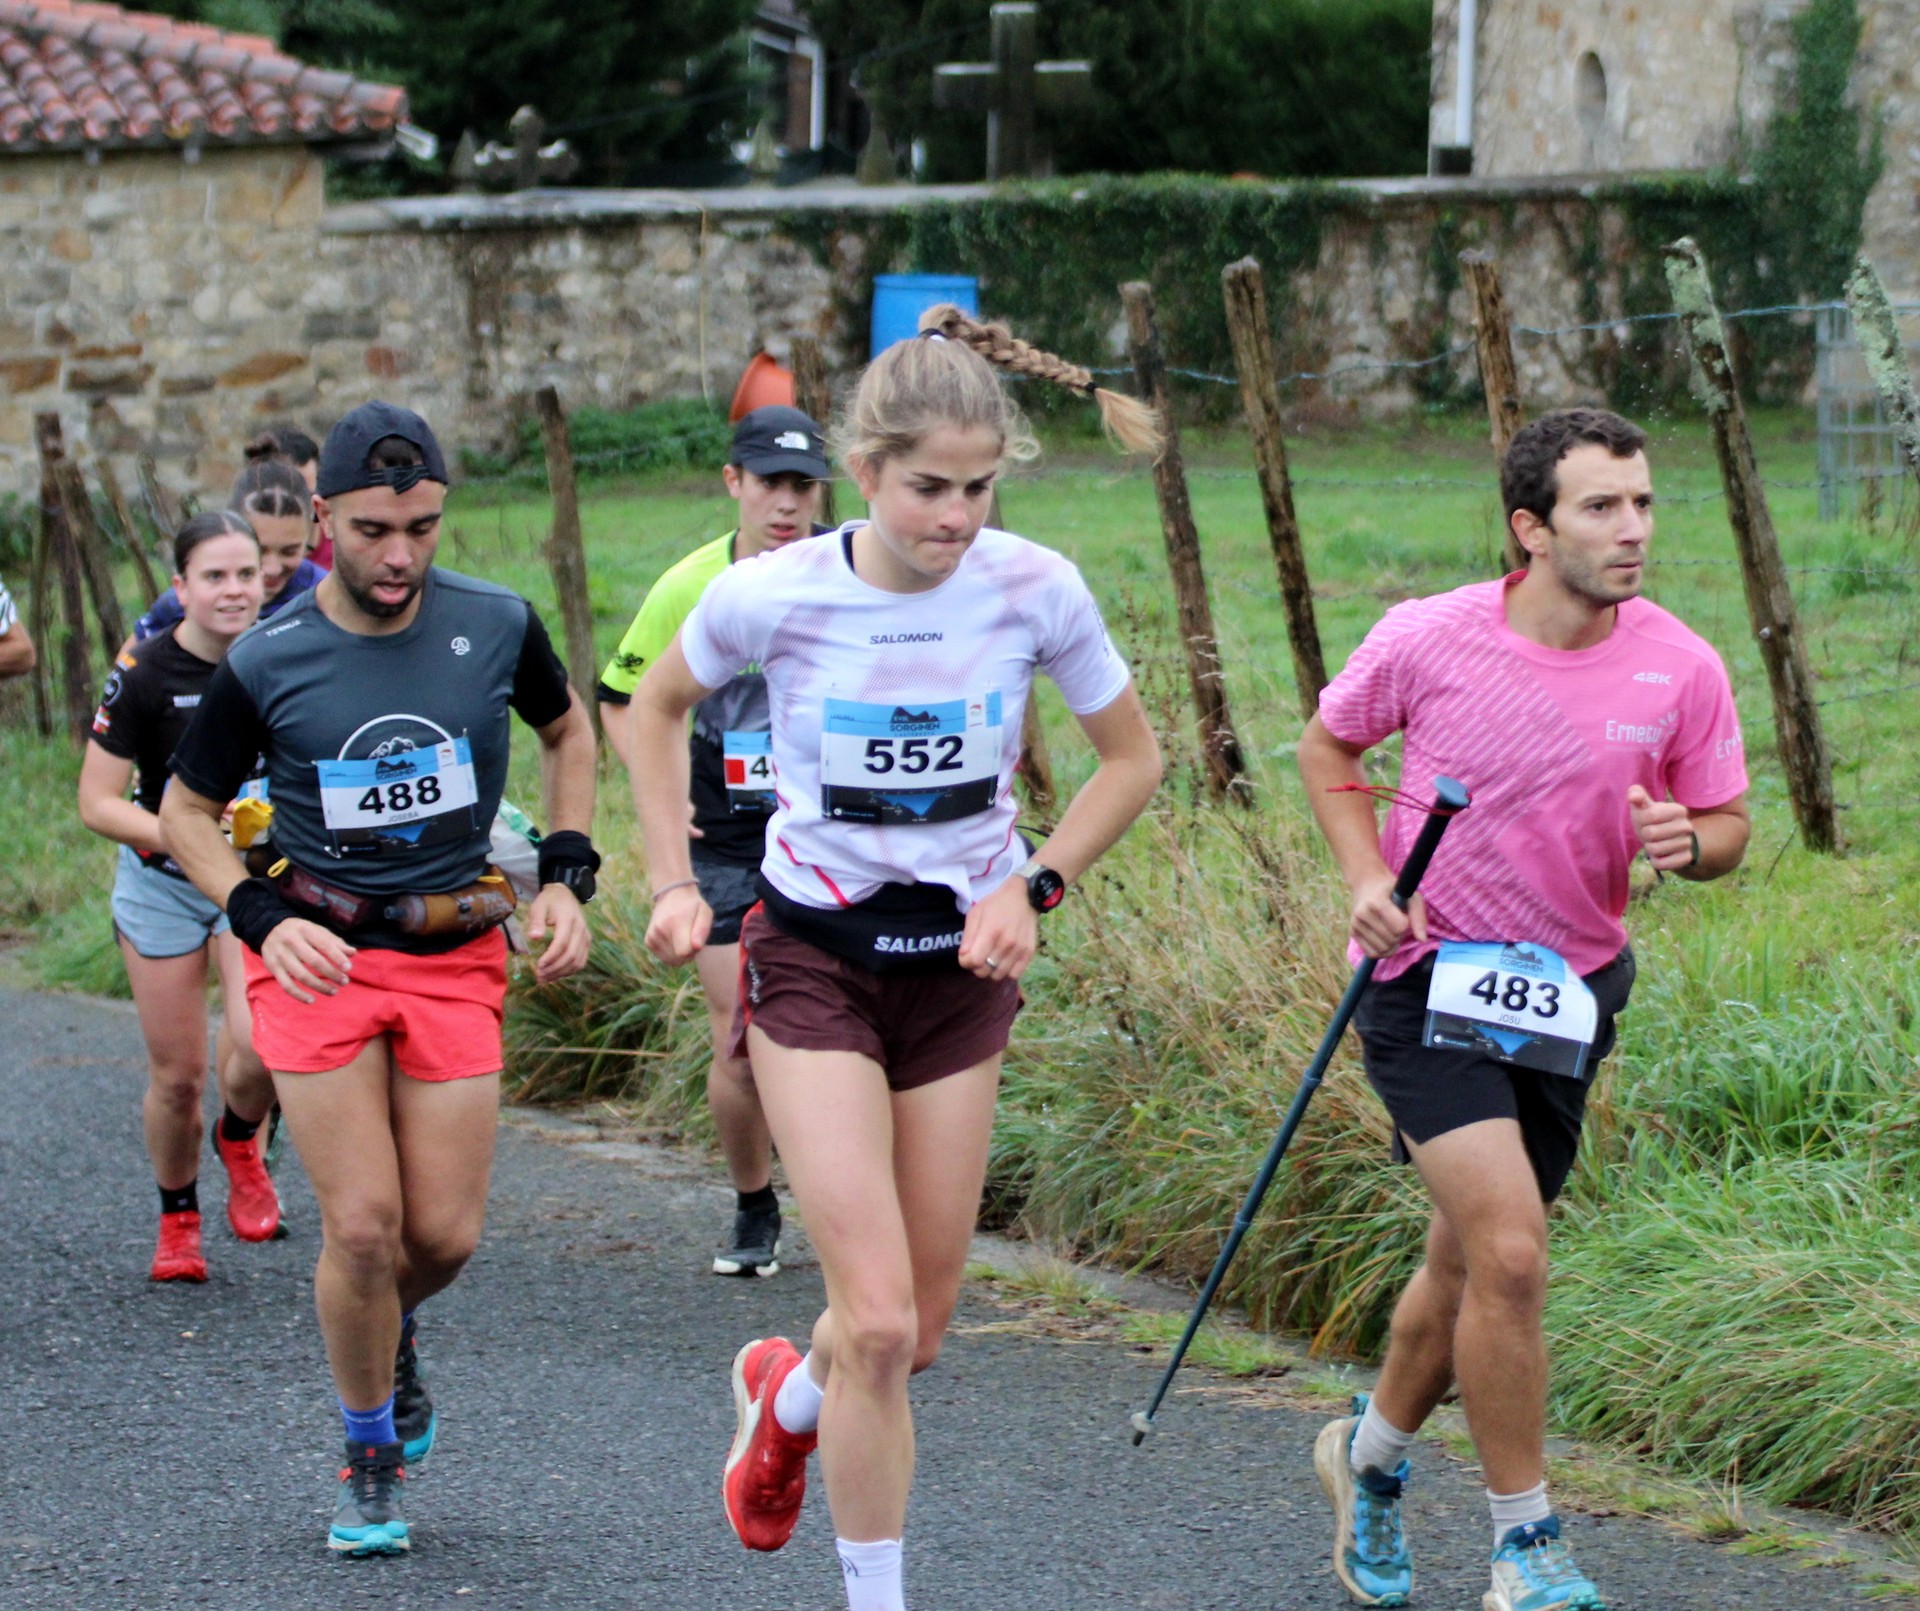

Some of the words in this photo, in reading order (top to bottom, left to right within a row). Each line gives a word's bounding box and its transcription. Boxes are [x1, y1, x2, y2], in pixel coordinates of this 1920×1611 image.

[869, 632, 943, 645] SALOMON
[1632, 672, 1672, 685] 42K
[863, 735, 964, 774] 552
[749, 755, 770, 779] 4
[357, 775, 442, 814] 488
[387, 811, 419, 823] JOSEBA
[874, 930, 964, 953] SALOMO
[1468, 970, 1560, 1019] 483
[1498, 1014, 1521, 1026] JOSU
